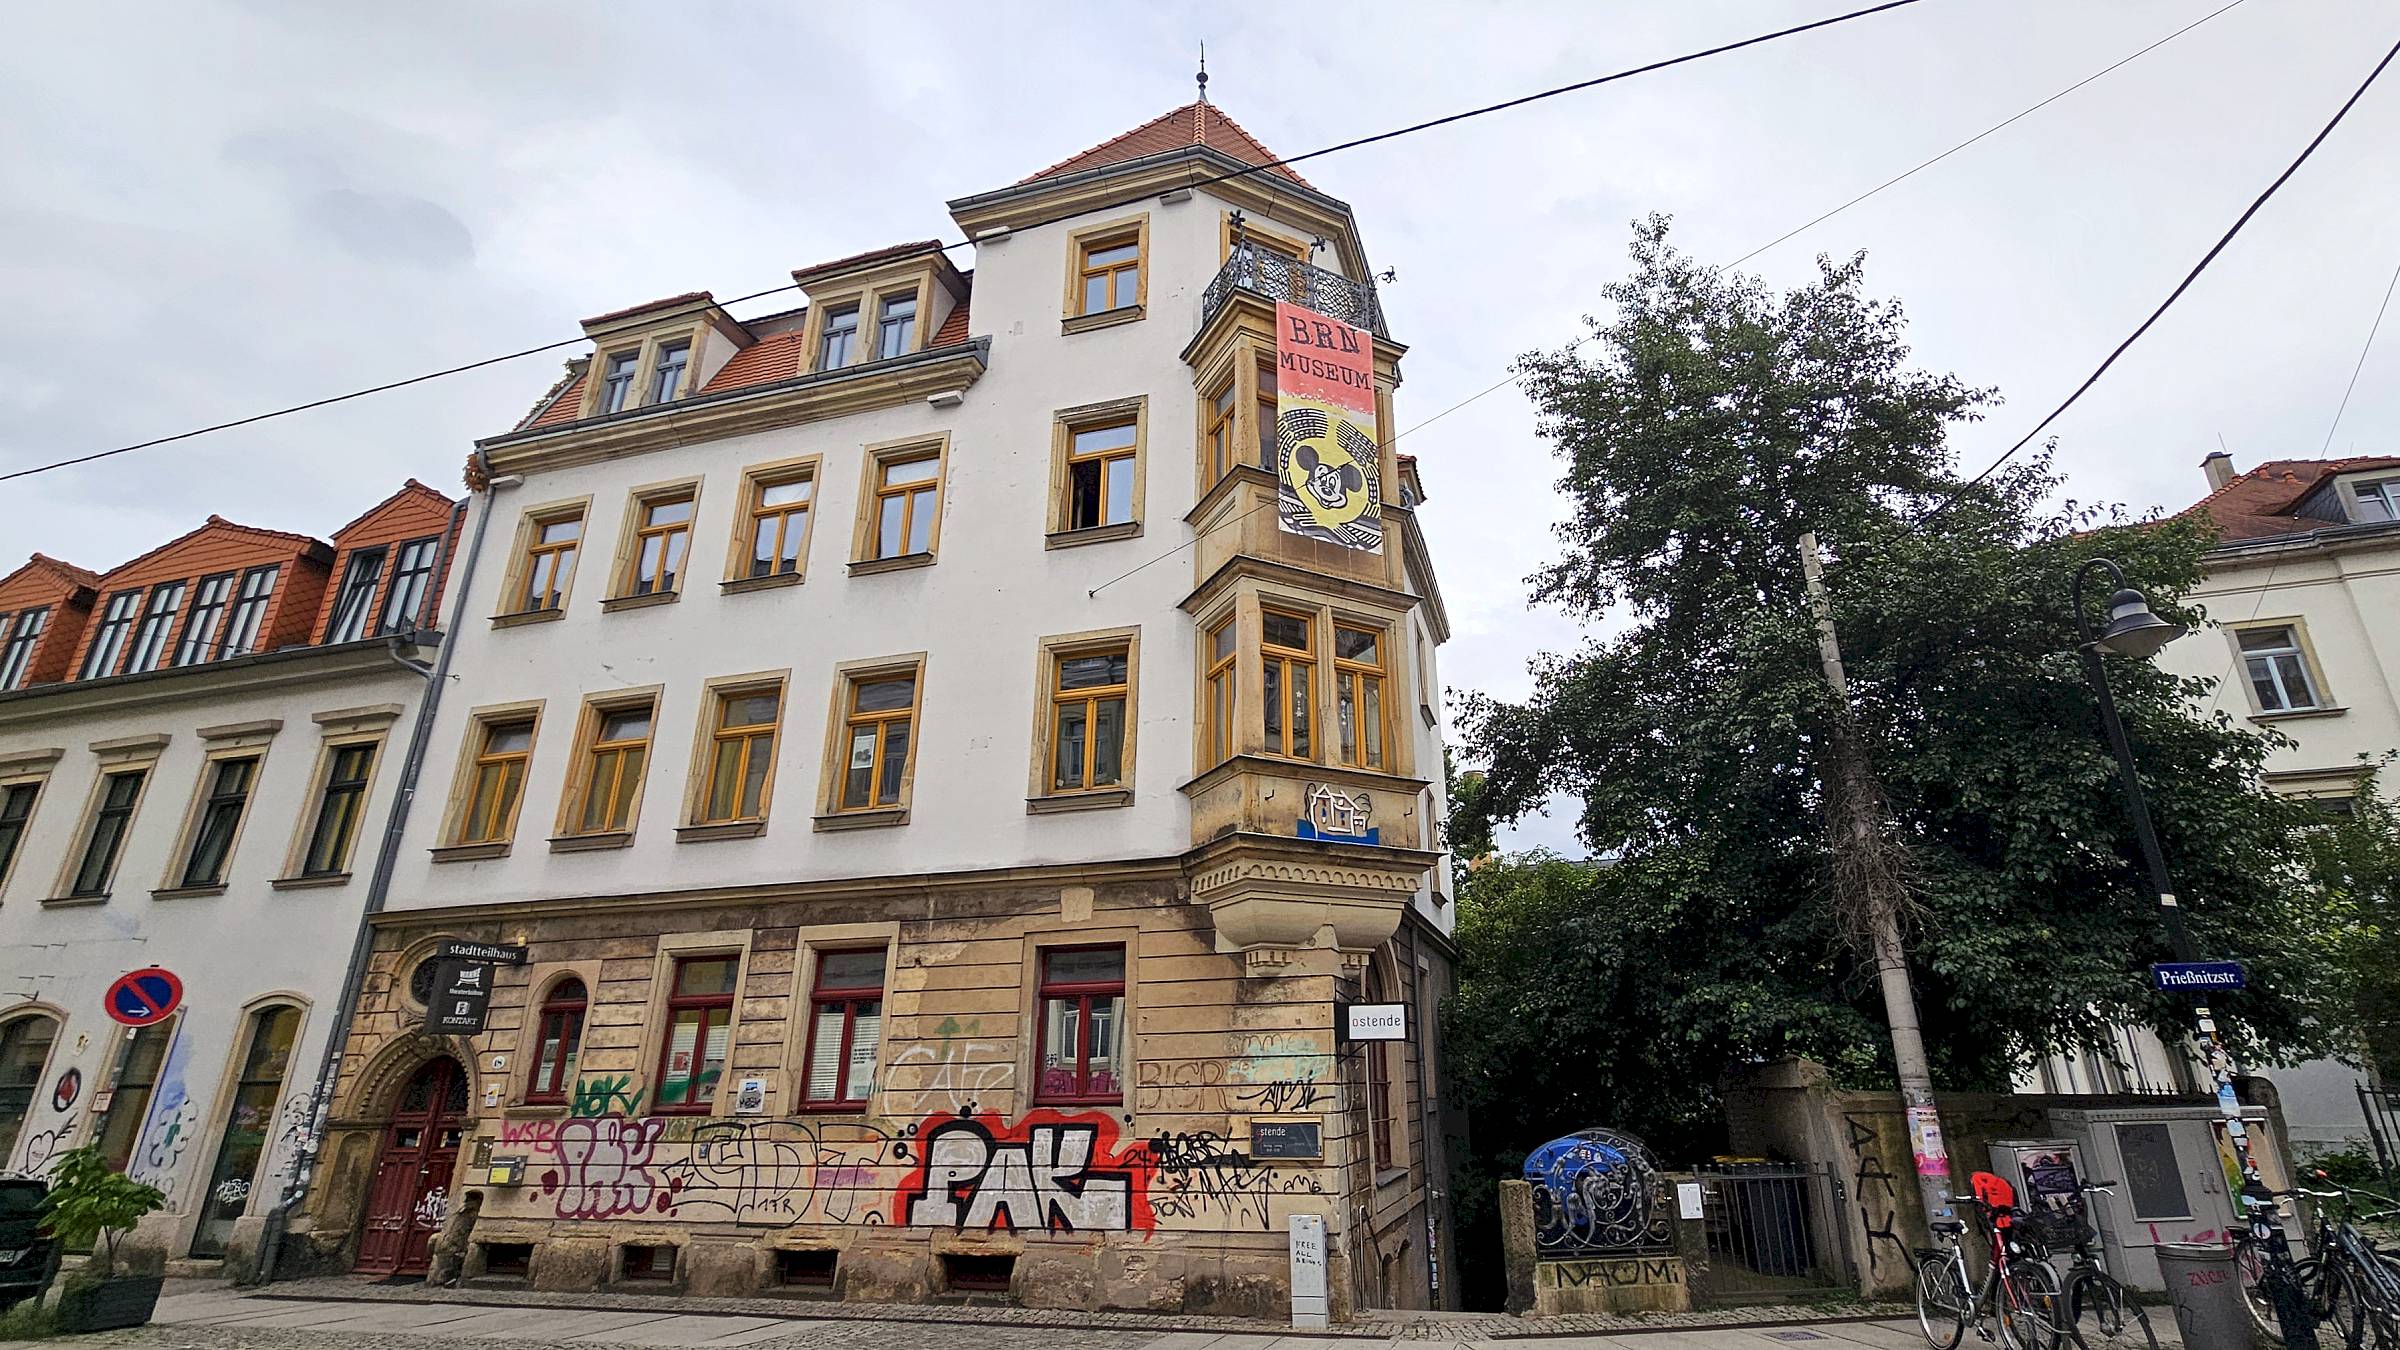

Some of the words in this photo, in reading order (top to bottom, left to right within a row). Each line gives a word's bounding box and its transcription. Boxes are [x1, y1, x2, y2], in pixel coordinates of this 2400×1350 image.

[1287, 316, 1360, 354] BRN
[1279, 350, 1372, 390] MUSEUM
[449, 945, 516, 959] stadtteilhaus
[2160, 970, 2239, 984] Prießnitzstr.
[442, 1016, 477, 1025] KONTAKT
[1352, 1014, 1401, 1028] ostende
[1139, 1061, 1232, 1112] BIER
[502, 1119, 558, 1153] WSB
[905, 1119, 1132, 1236] PAK
[1295, 1240, 1317, 1250] FREE
[1295, 1250, 1312, 1258] ALL
